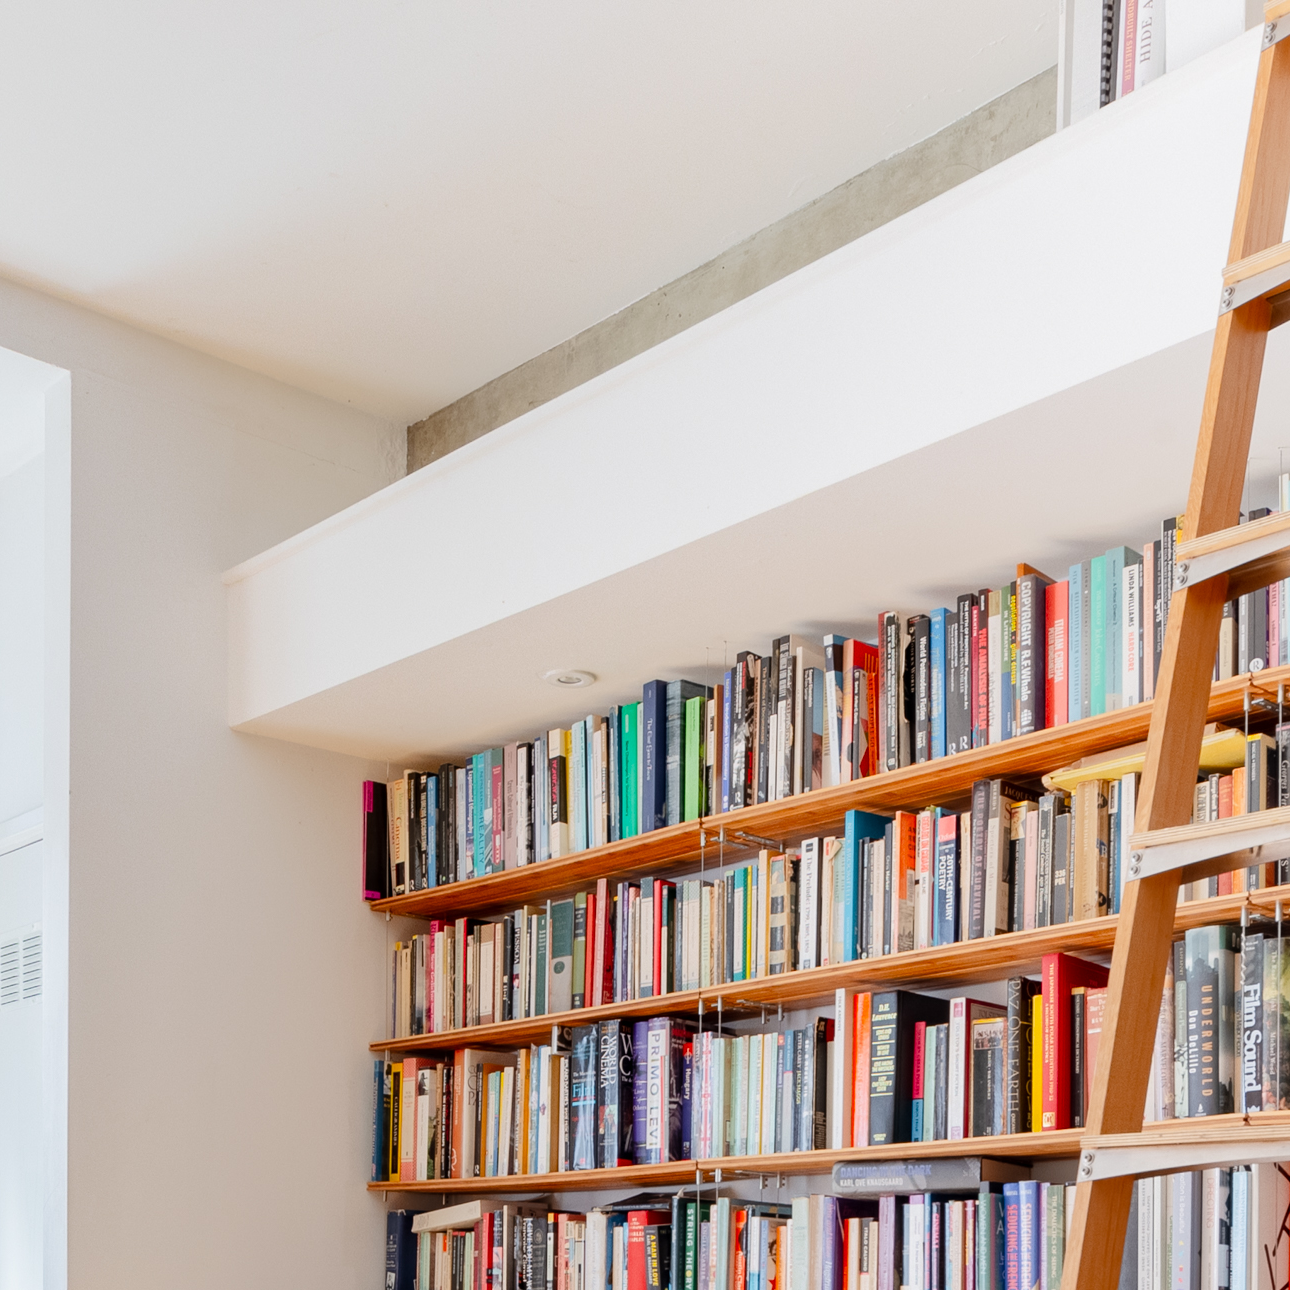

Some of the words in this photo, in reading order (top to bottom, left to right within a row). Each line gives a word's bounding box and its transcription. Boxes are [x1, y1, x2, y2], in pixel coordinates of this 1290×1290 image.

[1140, 17, 1152, 64] HIDE
[1125, 49, 1133, 82] SHELTER
[1055, 619, 1064, 646] ITALIAN
[1054, 648, 1065, 684] CINEMA
[945, 854, 953, 921] 20TH-CENTURY
[1189, 1010, 1198, 1024] Don
[1243, 983, 1260, 1028] Film
[600, 1036, 608, 1088] CINEMA
[609, 1036, 617, 1084] WORLD
[1189, 1028, 1199, 1074] DeLillo
[1201, 984, 1213, 1097] UNDERWORLD
[1245, 1030, 1261, 1092] Sound
[650, 1033, 660, 1096] PRIMO
[649, 1106, 658, 1146] LEVI
[686, 1209, 694, 1247] STRING
